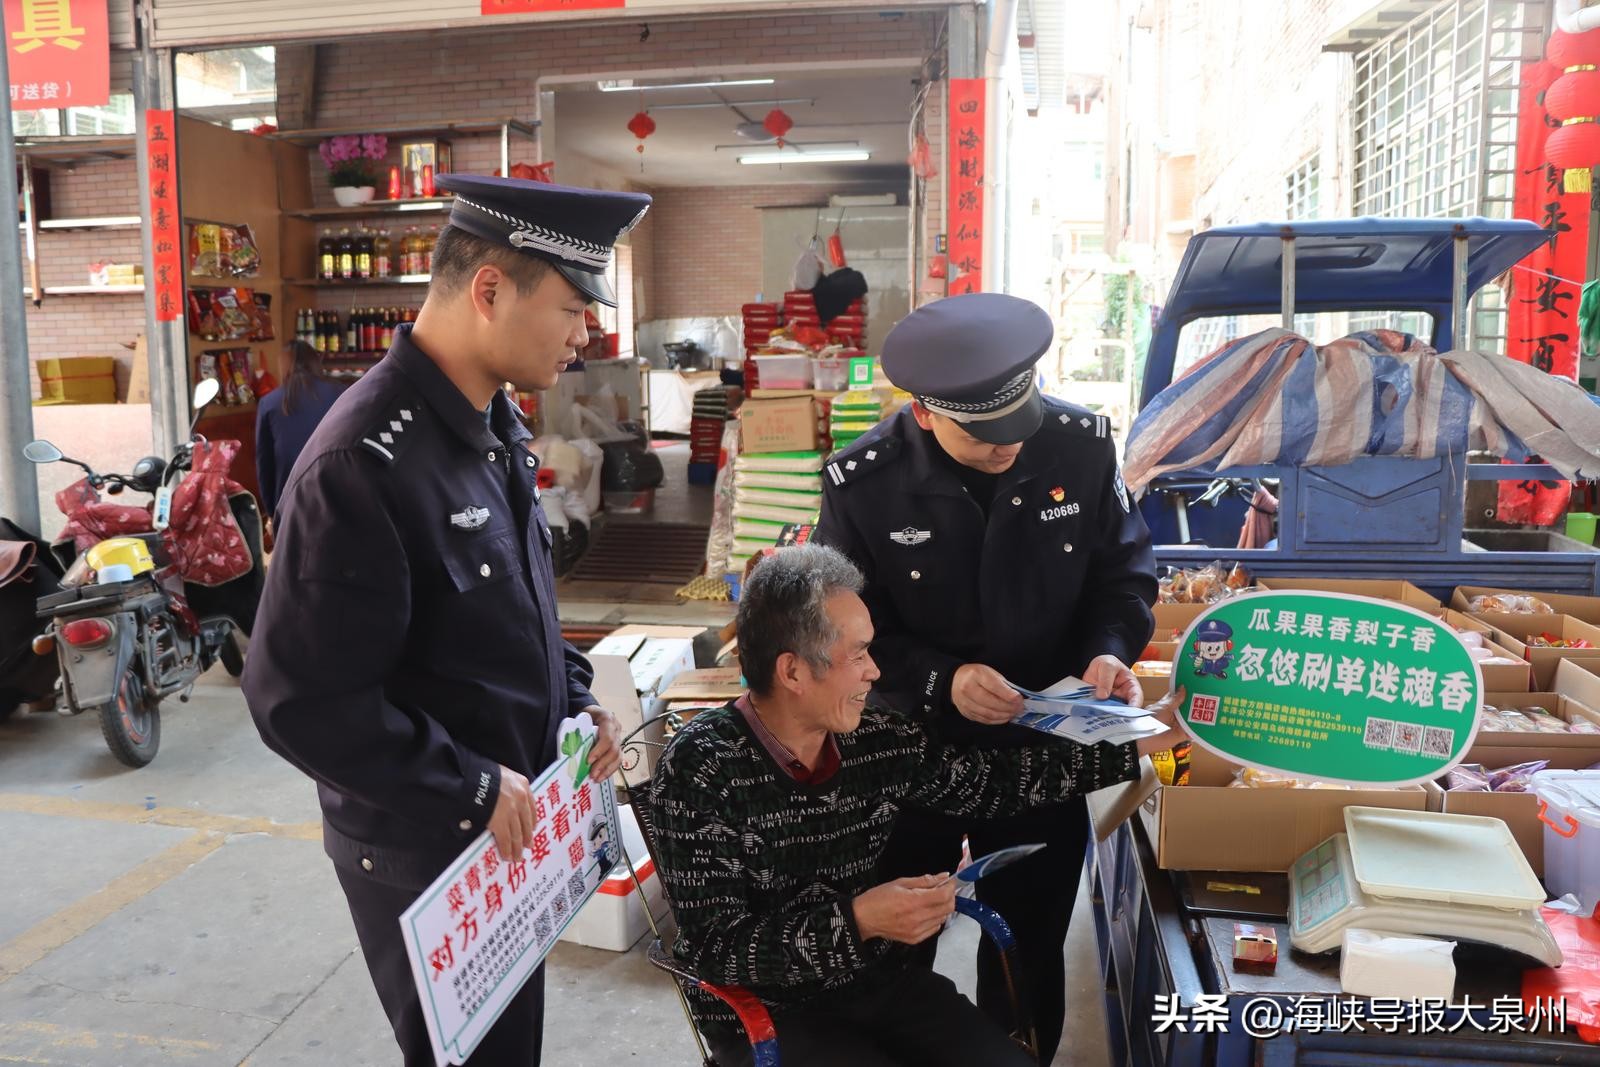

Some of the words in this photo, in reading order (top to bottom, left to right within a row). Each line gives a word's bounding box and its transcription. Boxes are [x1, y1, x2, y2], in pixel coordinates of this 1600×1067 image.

[1040, 502, 1080, 522] 420689
[1248, 608, 1437, 654] 瓜果果香梨子香
[925, 669, 938, 696] POLICE
[1235, 643, 1474, 714] 忽悠刷单迷魂香
[474, 771, 491, 806] POLICE
[445, 779, 562, 917] 菜青葱苗青
[427, 782, 593, 983] 对方身份要看清
